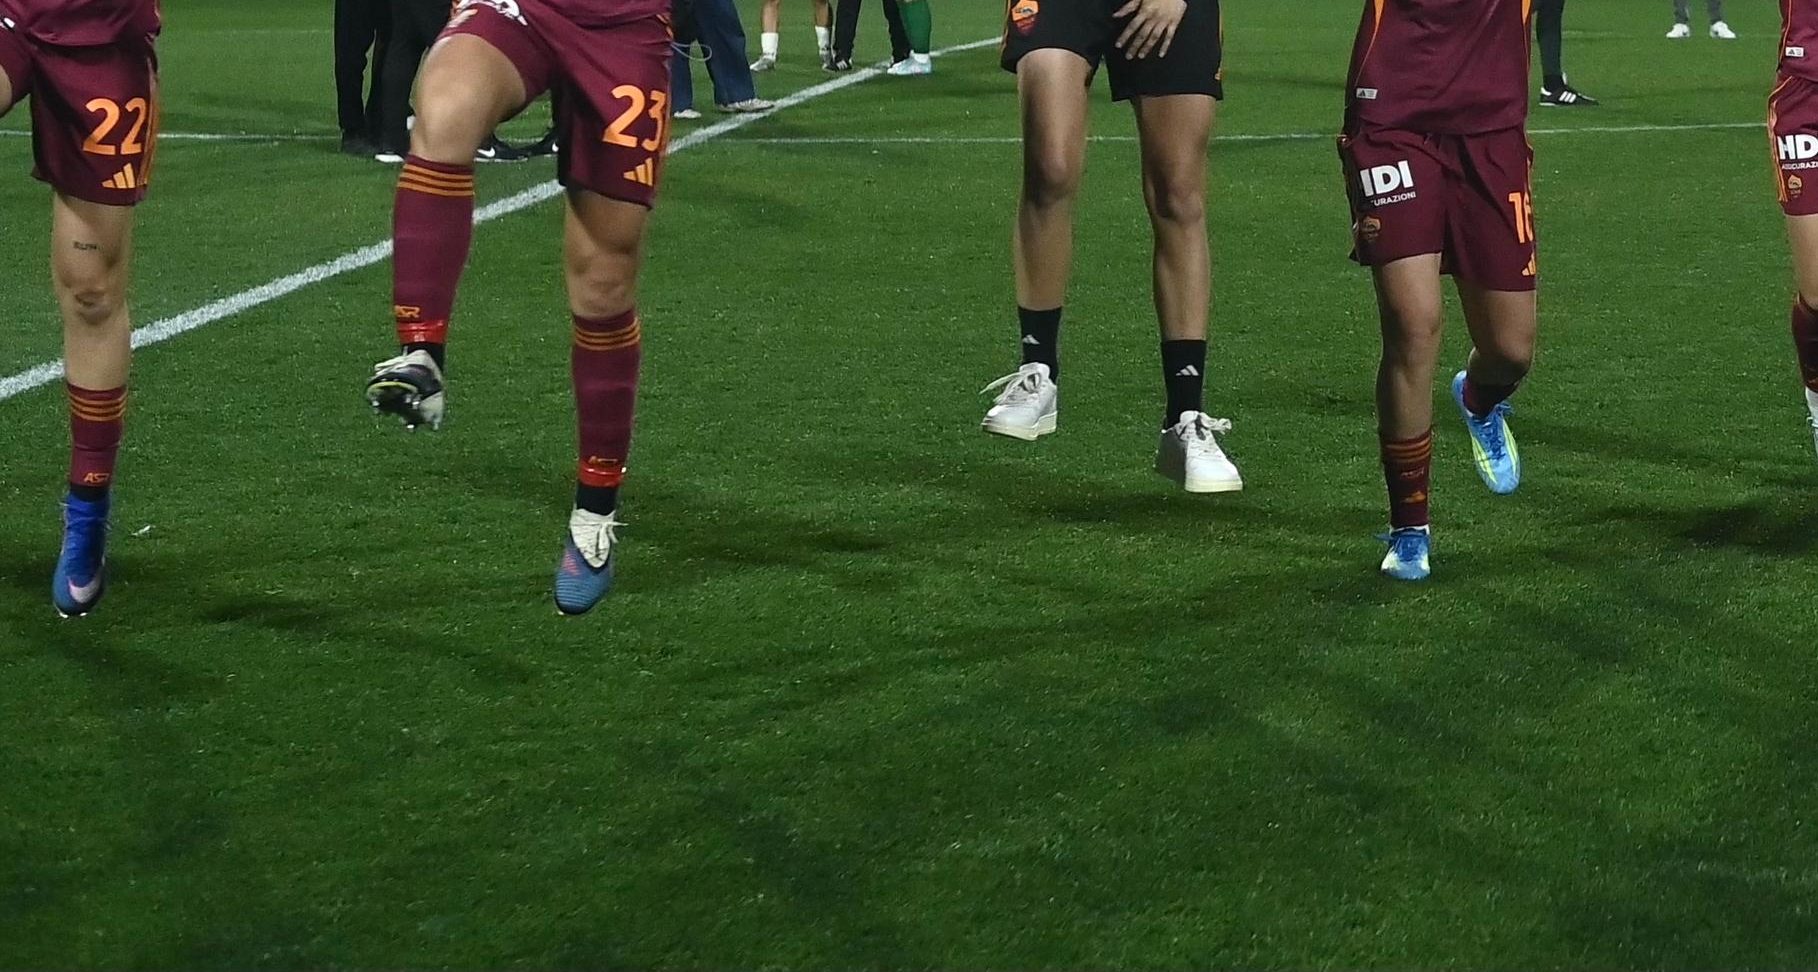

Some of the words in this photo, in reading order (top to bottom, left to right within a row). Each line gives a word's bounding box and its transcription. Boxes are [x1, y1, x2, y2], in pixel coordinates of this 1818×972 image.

[83, 98, 147, 156] 22
[603, 84, 667, 152] 23
[1373, 191, 1417, 207] URAZIONI
